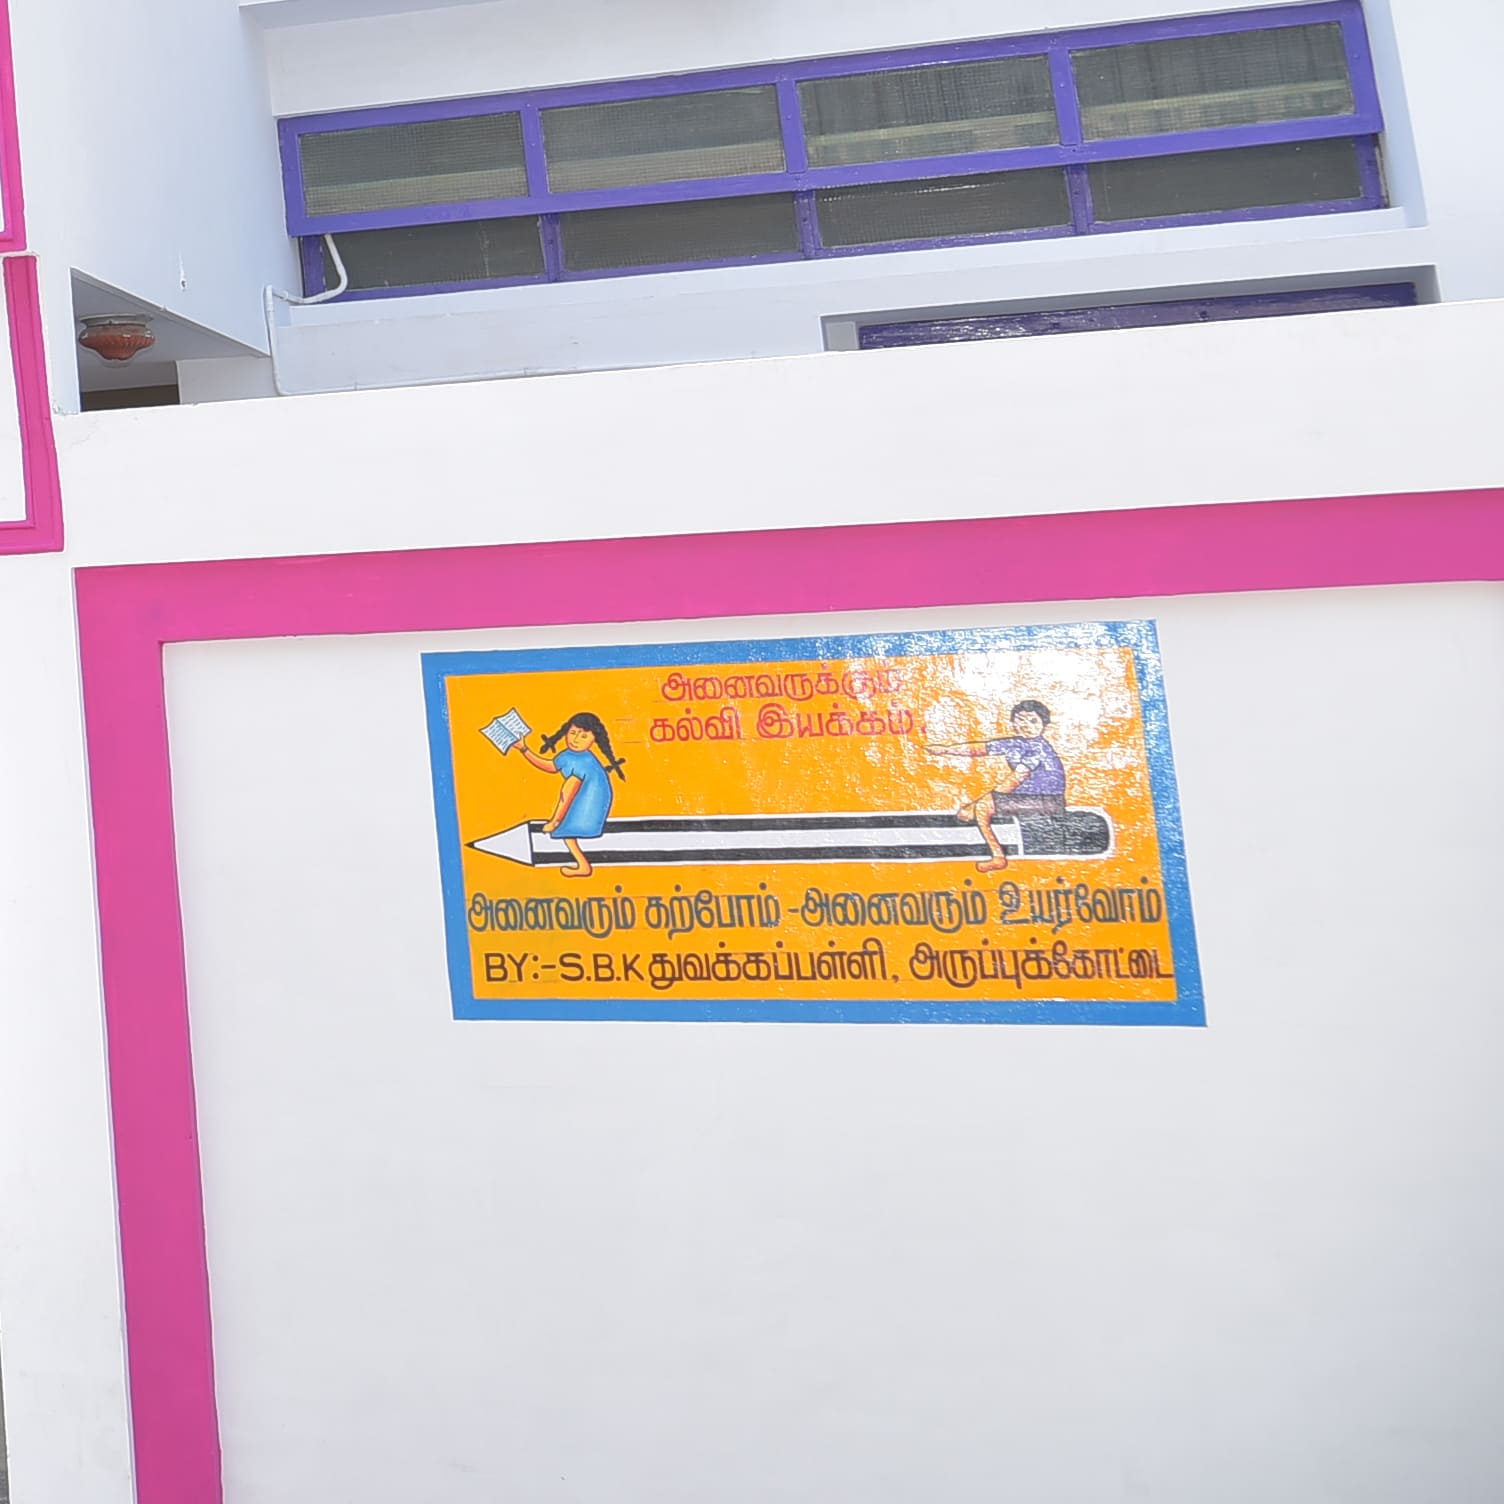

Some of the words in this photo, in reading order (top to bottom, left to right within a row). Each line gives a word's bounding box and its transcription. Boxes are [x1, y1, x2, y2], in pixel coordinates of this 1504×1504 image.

[660, 662, 902, 702] அனைவருக்கும்
[649, 705, 742, 742] கல்வி
[467, 884, 637, 939] அனைவரும்
[644, 882, 781, 940] கற்போம்
[999, 876, 1163, 934] உயர்வோம்
[909, 936, 1176, 989] அருப்புக்கோட்டை
